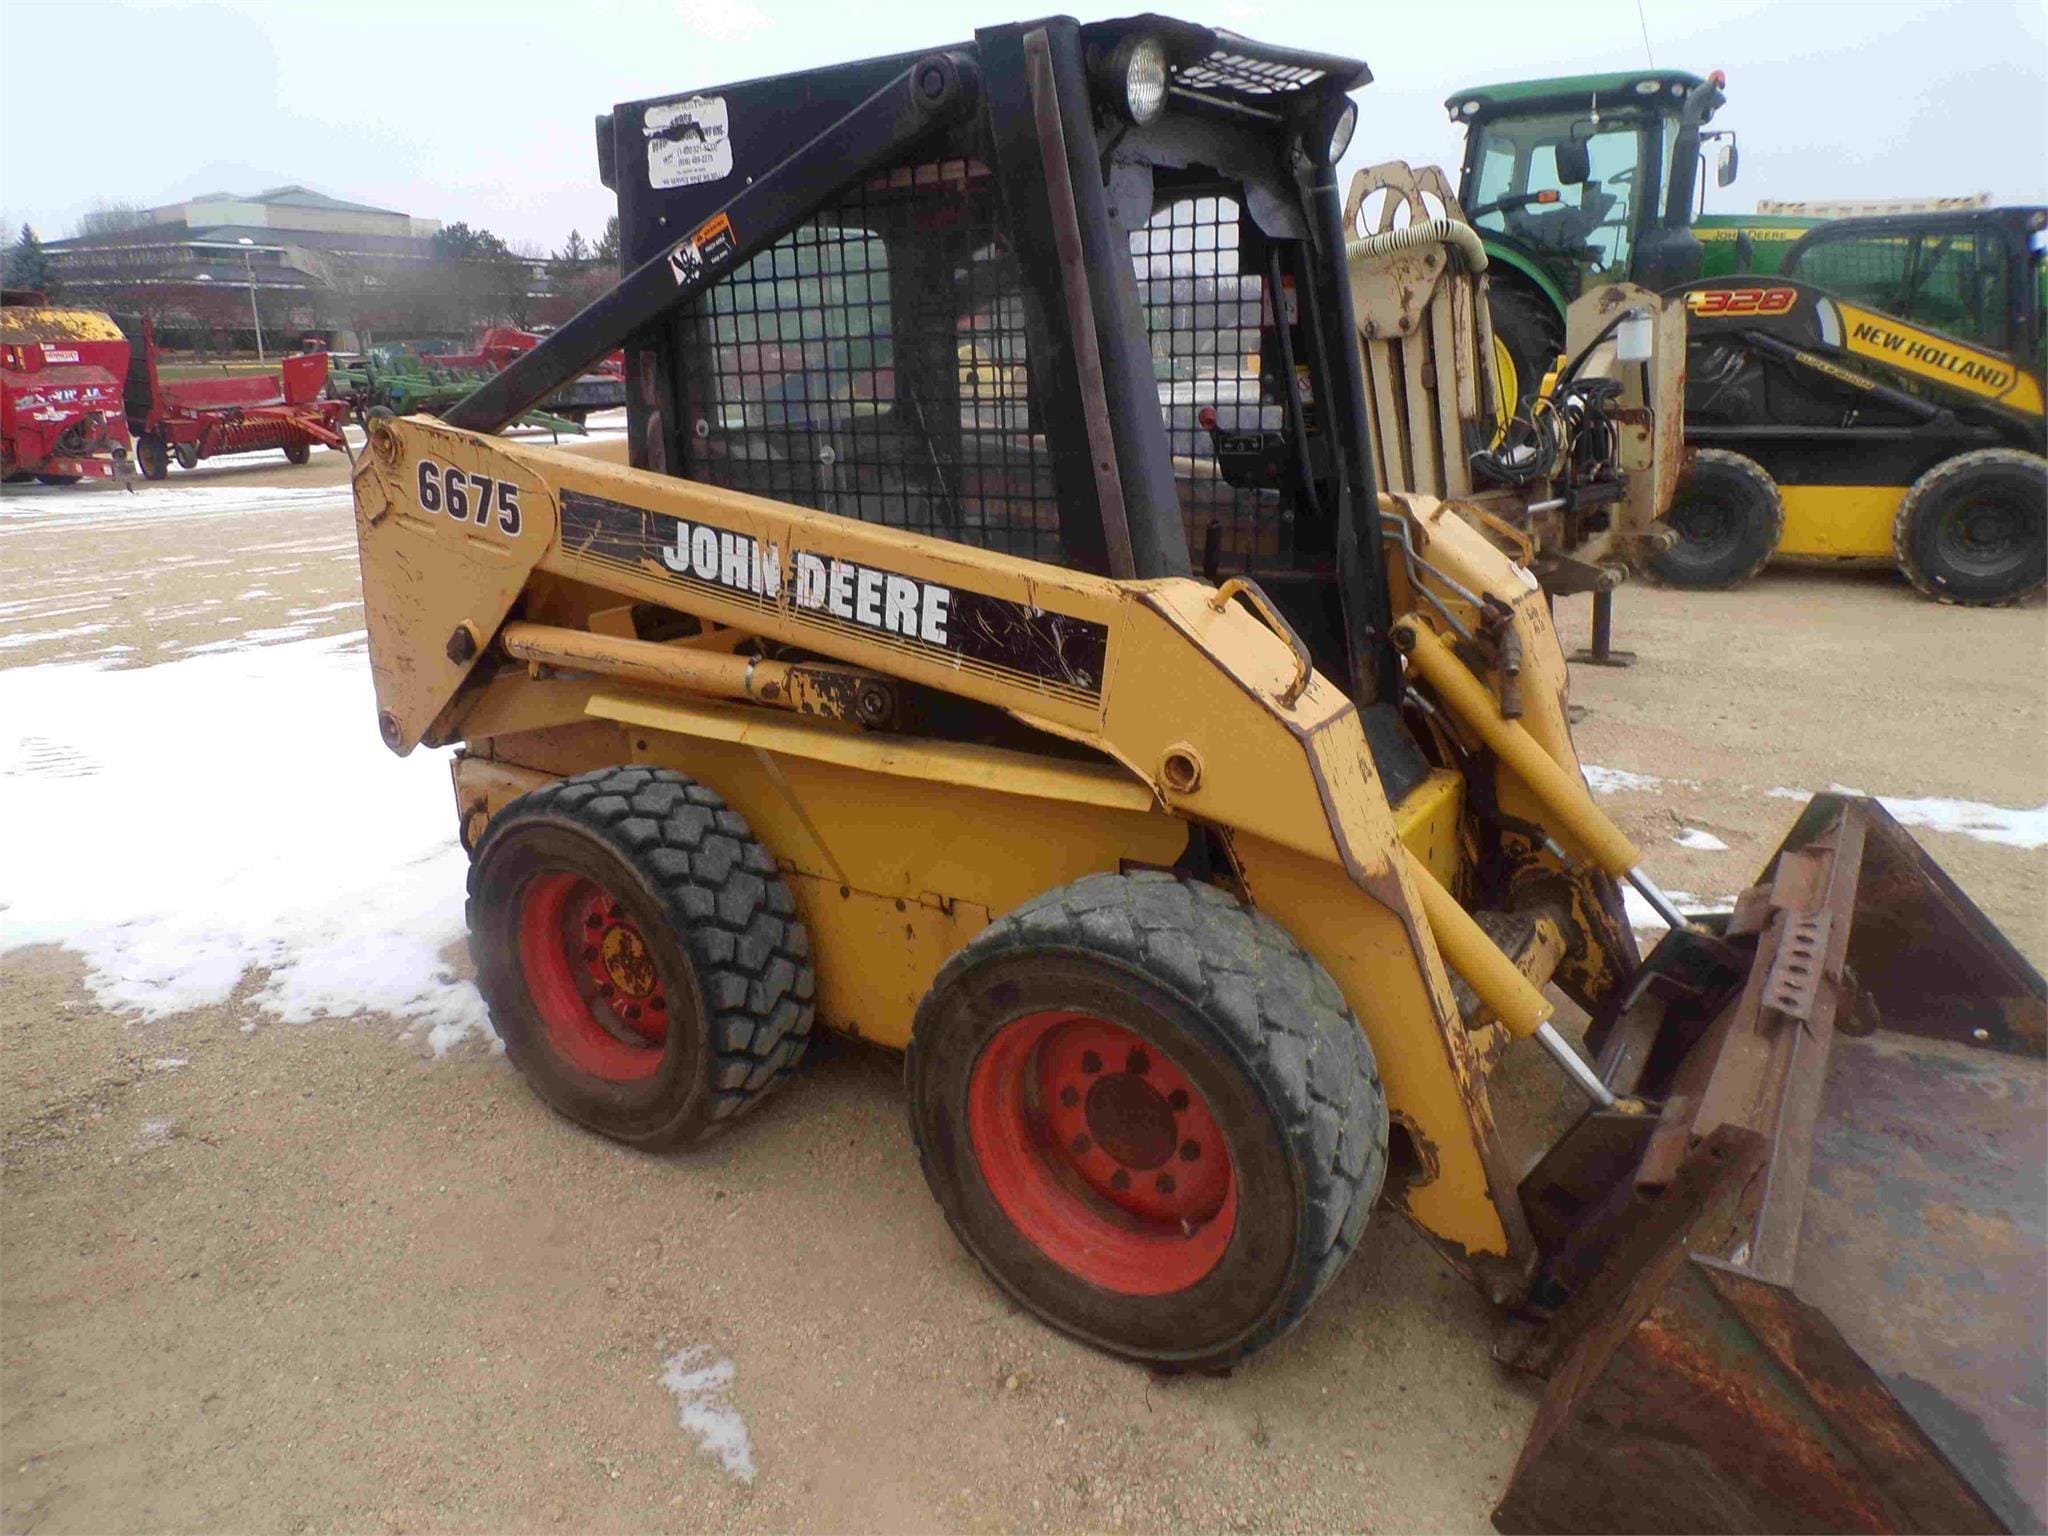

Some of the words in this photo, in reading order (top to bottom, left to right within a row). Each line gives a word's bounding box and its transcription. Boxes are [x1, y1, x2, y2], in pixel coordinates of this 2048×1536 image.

[1716, 230, 1738, 241] JOH
[1747, 229, 1787, 241] DEERE
[1853, 323, 1906, 351] NEW
[1906, 341, 2009, 389] HOLLAND
[417, 460, 522, 537] 6675
[662, 520, 782, 600] JOHN
[794, 551, 950, 646] DEERE
